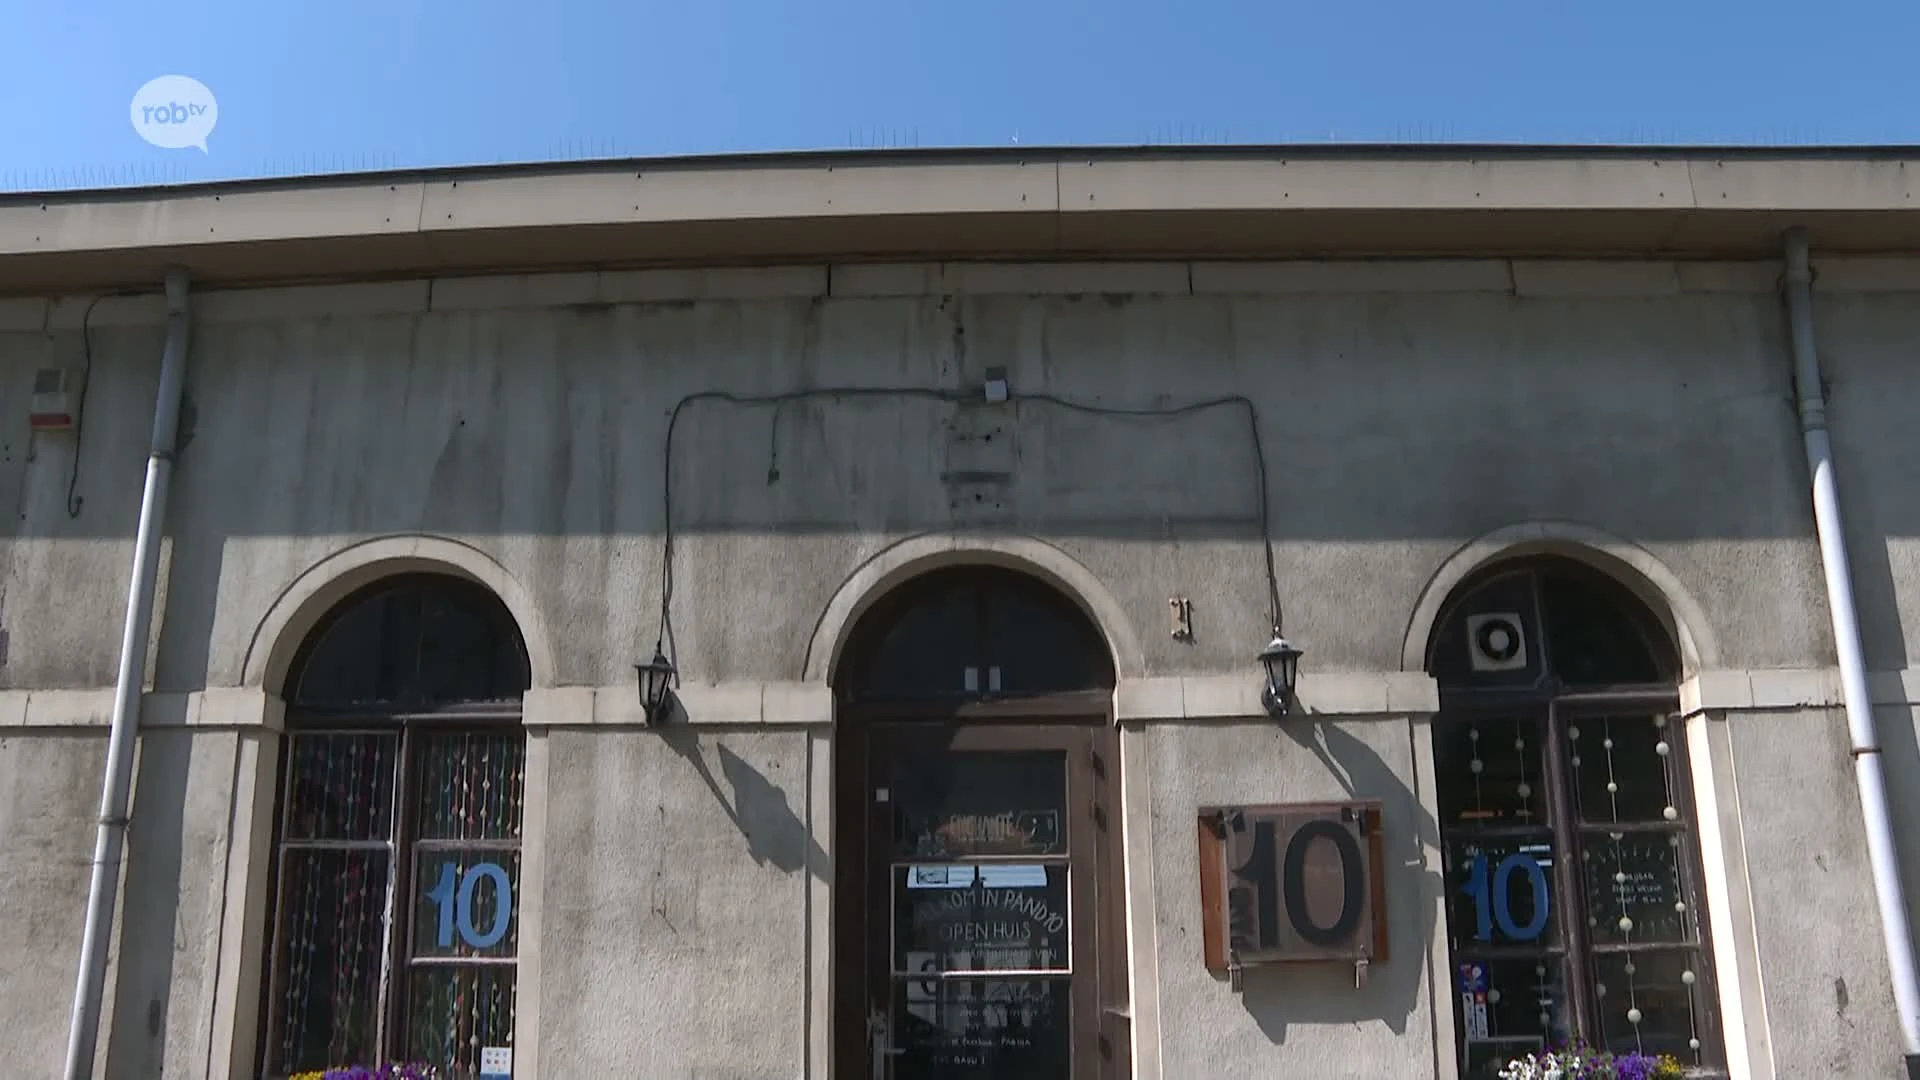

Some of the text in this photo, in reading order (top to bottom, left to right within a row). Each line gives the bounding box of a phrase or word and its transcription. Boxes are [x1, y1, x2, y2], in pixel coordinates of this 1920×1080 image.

[424, 862, 512, 948] 10
[980, 889, 999, 907] IN
[1231, 819, 1364, 947] 10
[1459, 849, 1550, 944] 10
[939, 920, 1032, 941] OPEN HUIS
